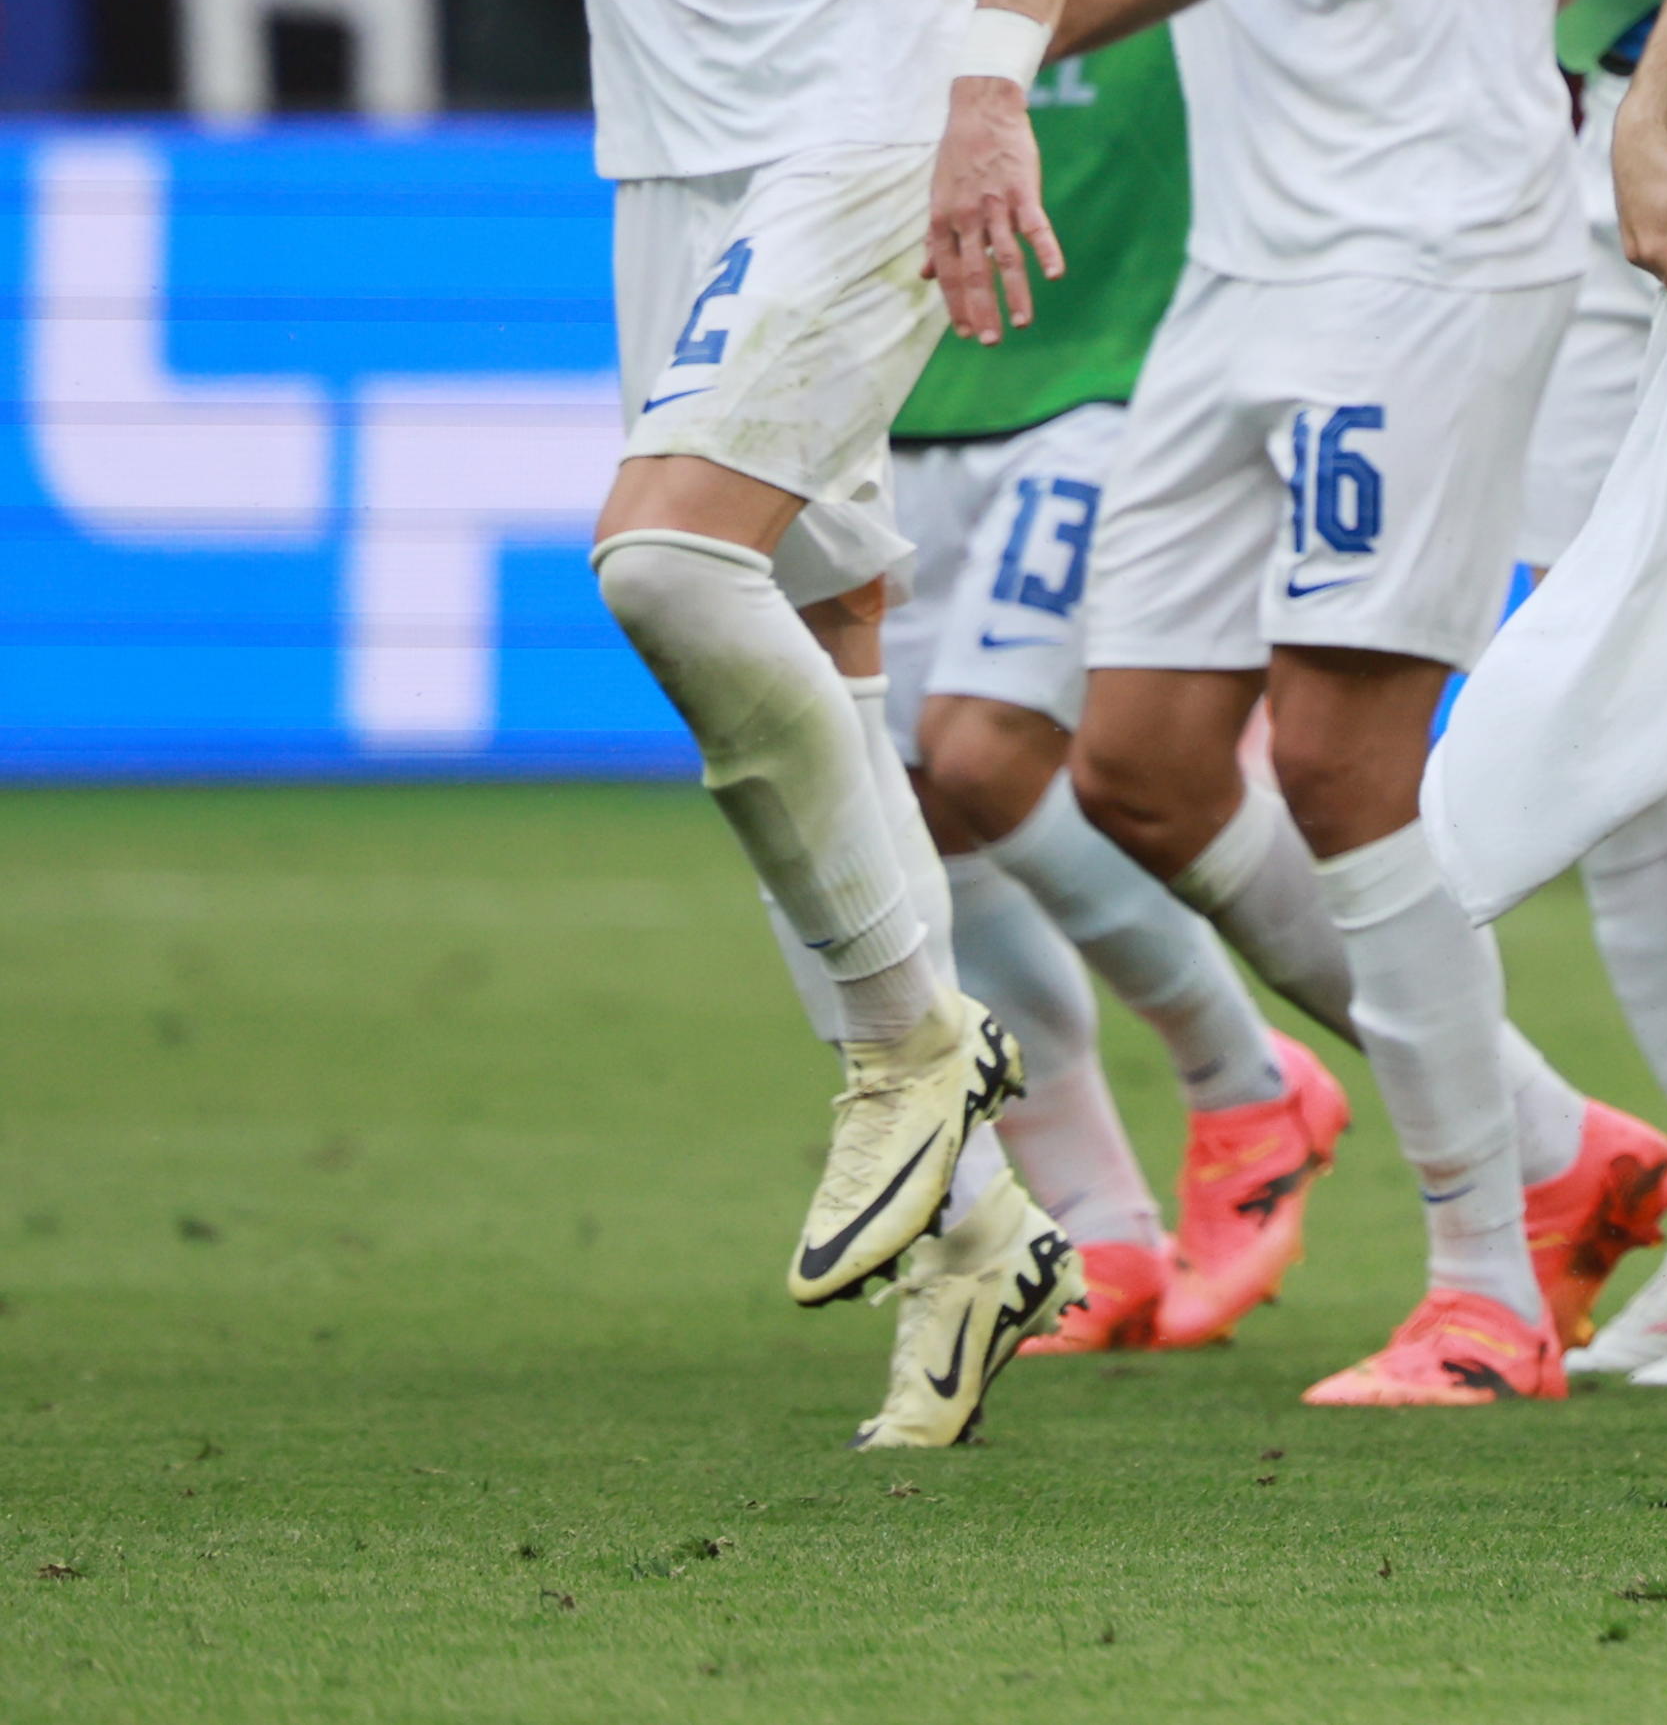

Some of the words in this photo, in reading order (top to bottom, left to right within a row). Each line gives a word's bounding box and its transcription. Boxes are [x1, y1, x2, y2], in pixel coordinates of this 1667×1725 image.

[672, 237, 753, 369] 2
[993, 478, 1101, 617] 13
[1287, 405, 1384, 554] 16
